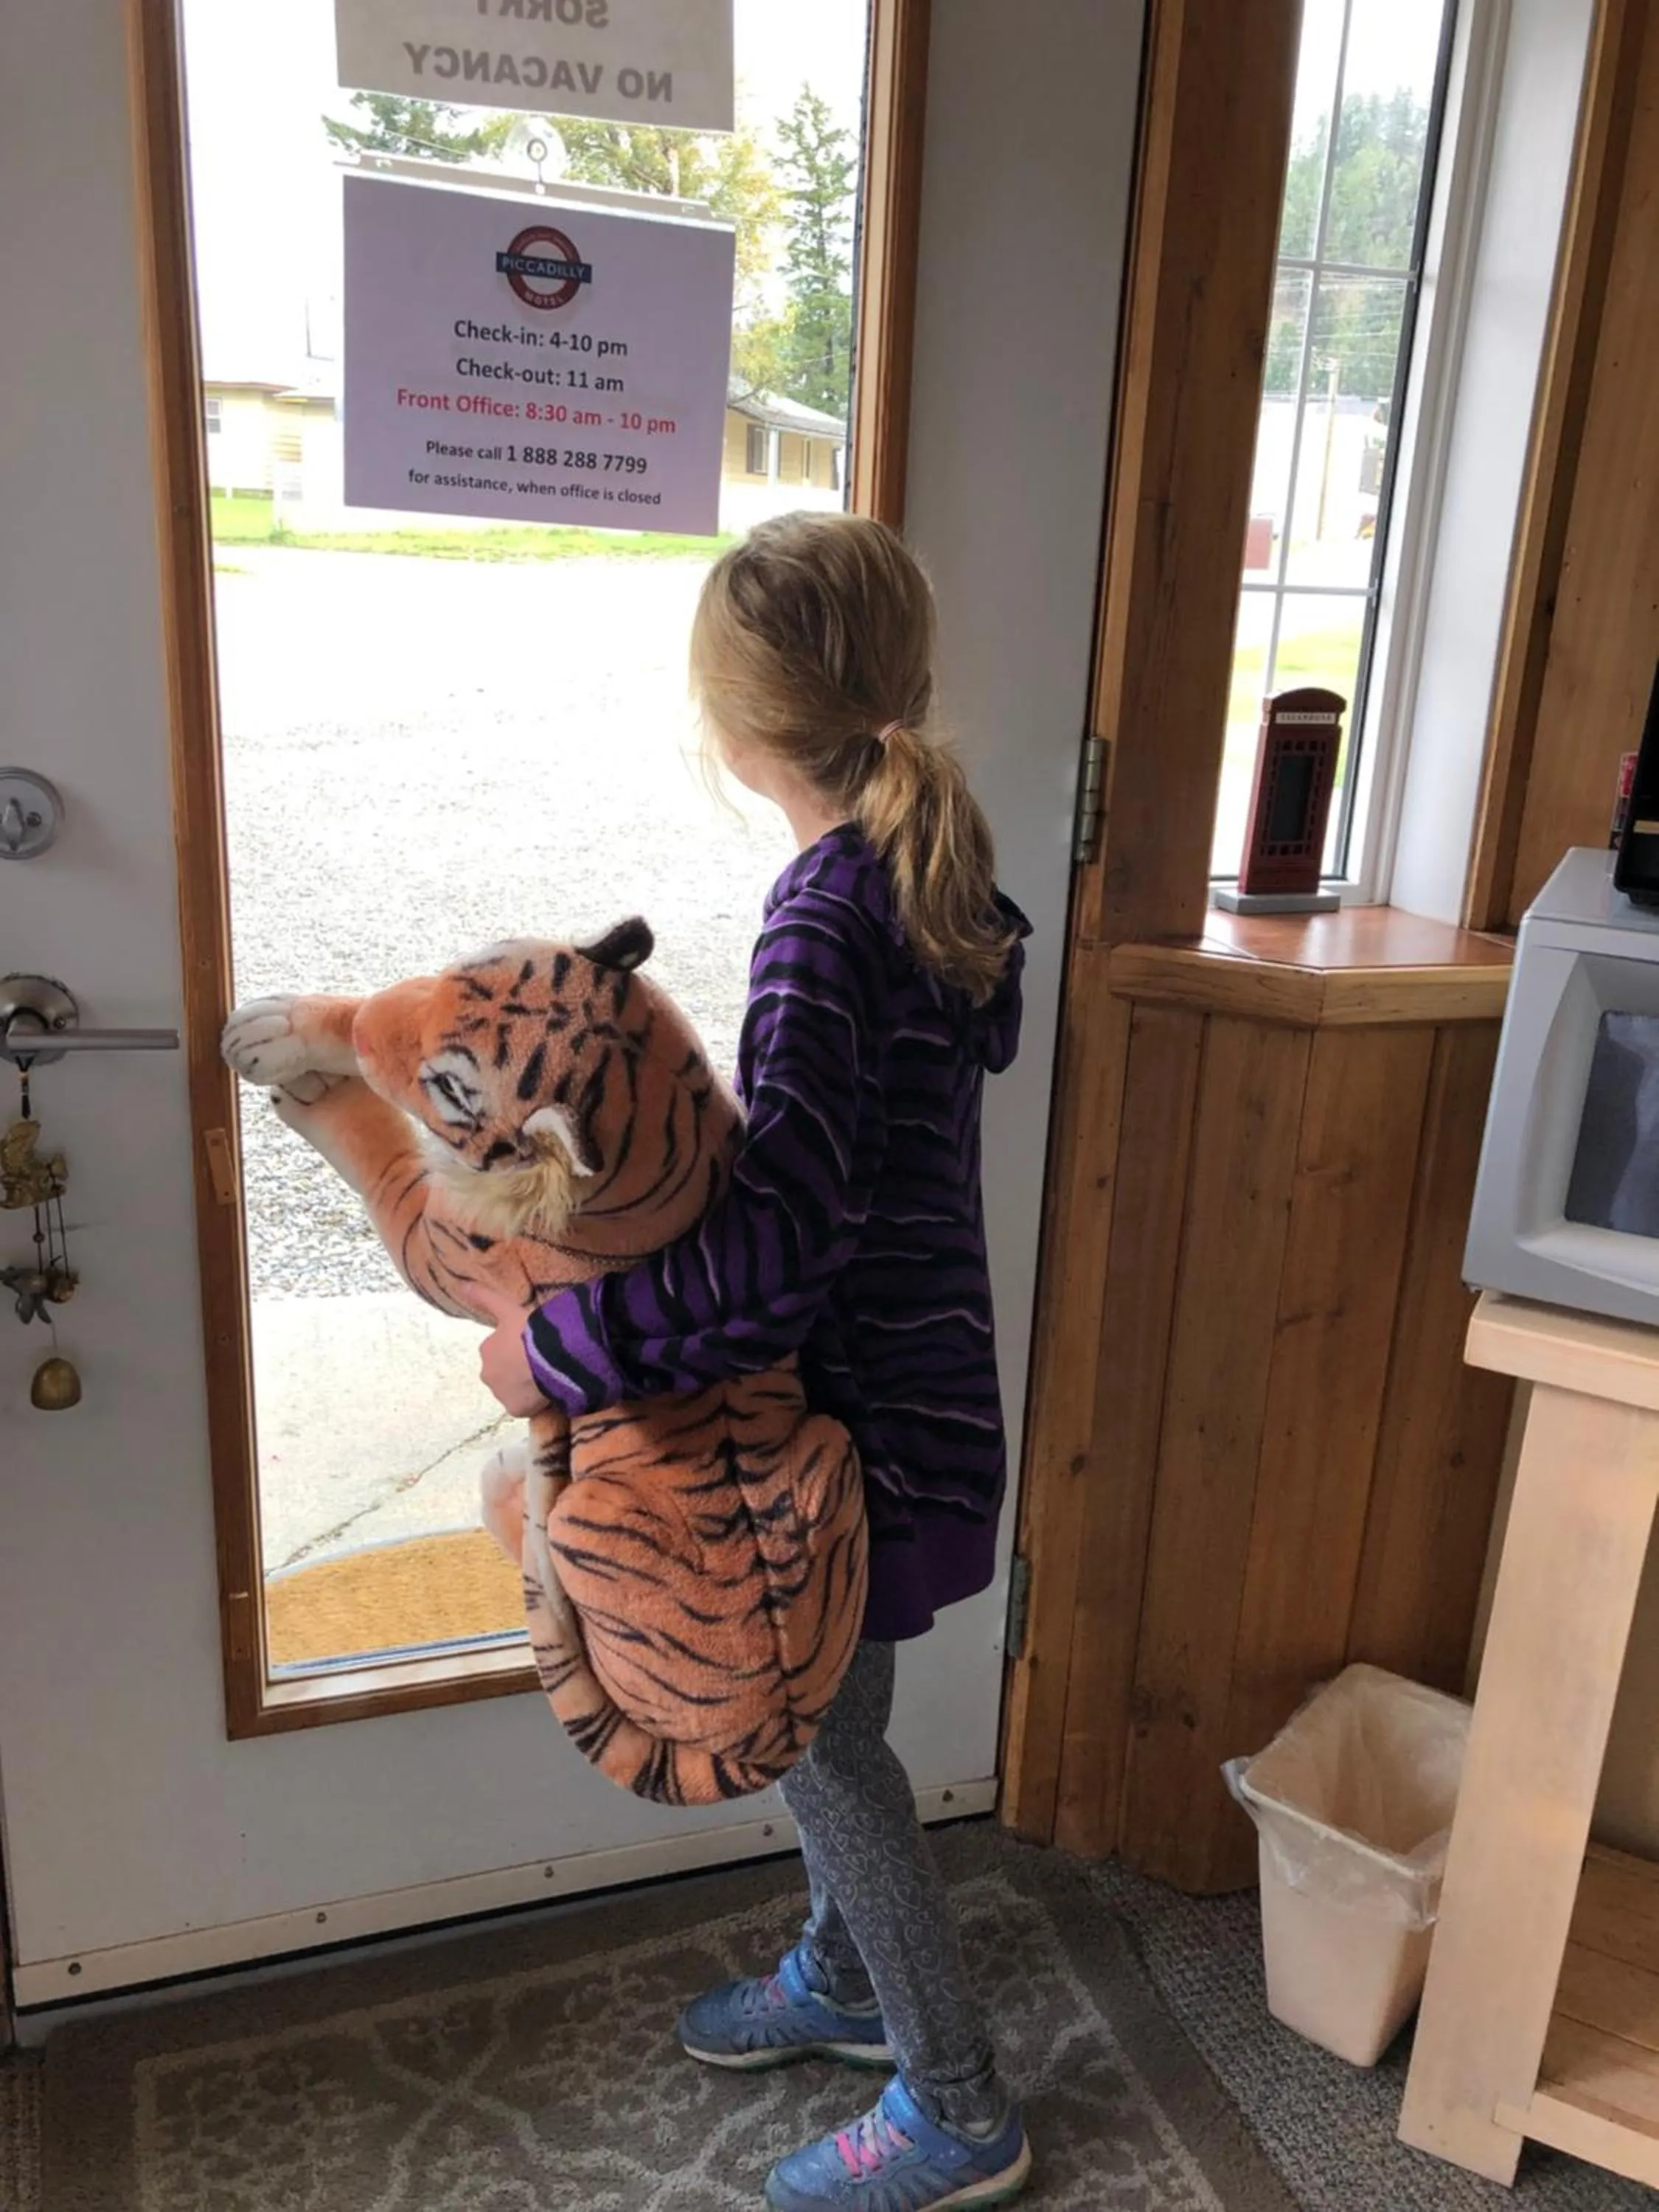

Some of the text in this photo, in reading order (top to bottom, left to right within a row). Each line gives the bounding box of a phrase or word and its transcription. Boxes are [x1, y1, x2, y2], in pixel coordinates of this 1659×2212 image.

[502, 255, 585, 278] PICCADILLY
[454, 320, 627, 357] Check-in: 4-10 pm
[456, 358, 625, 392] Check-out: 11 am
[397, 389, 451, 411] Front
[456, 394, 520, 417] Office:
[526, 402, 567, 422] 8:30
[573, 411, 602, 425] am
[620, 412, 642, 430] 10
[647, 419, 676, 435] pm
[426, 440, 647, 474] Please call 1 888 288 7799
[408, 468, 661, 505] for assistance, when office is closed
